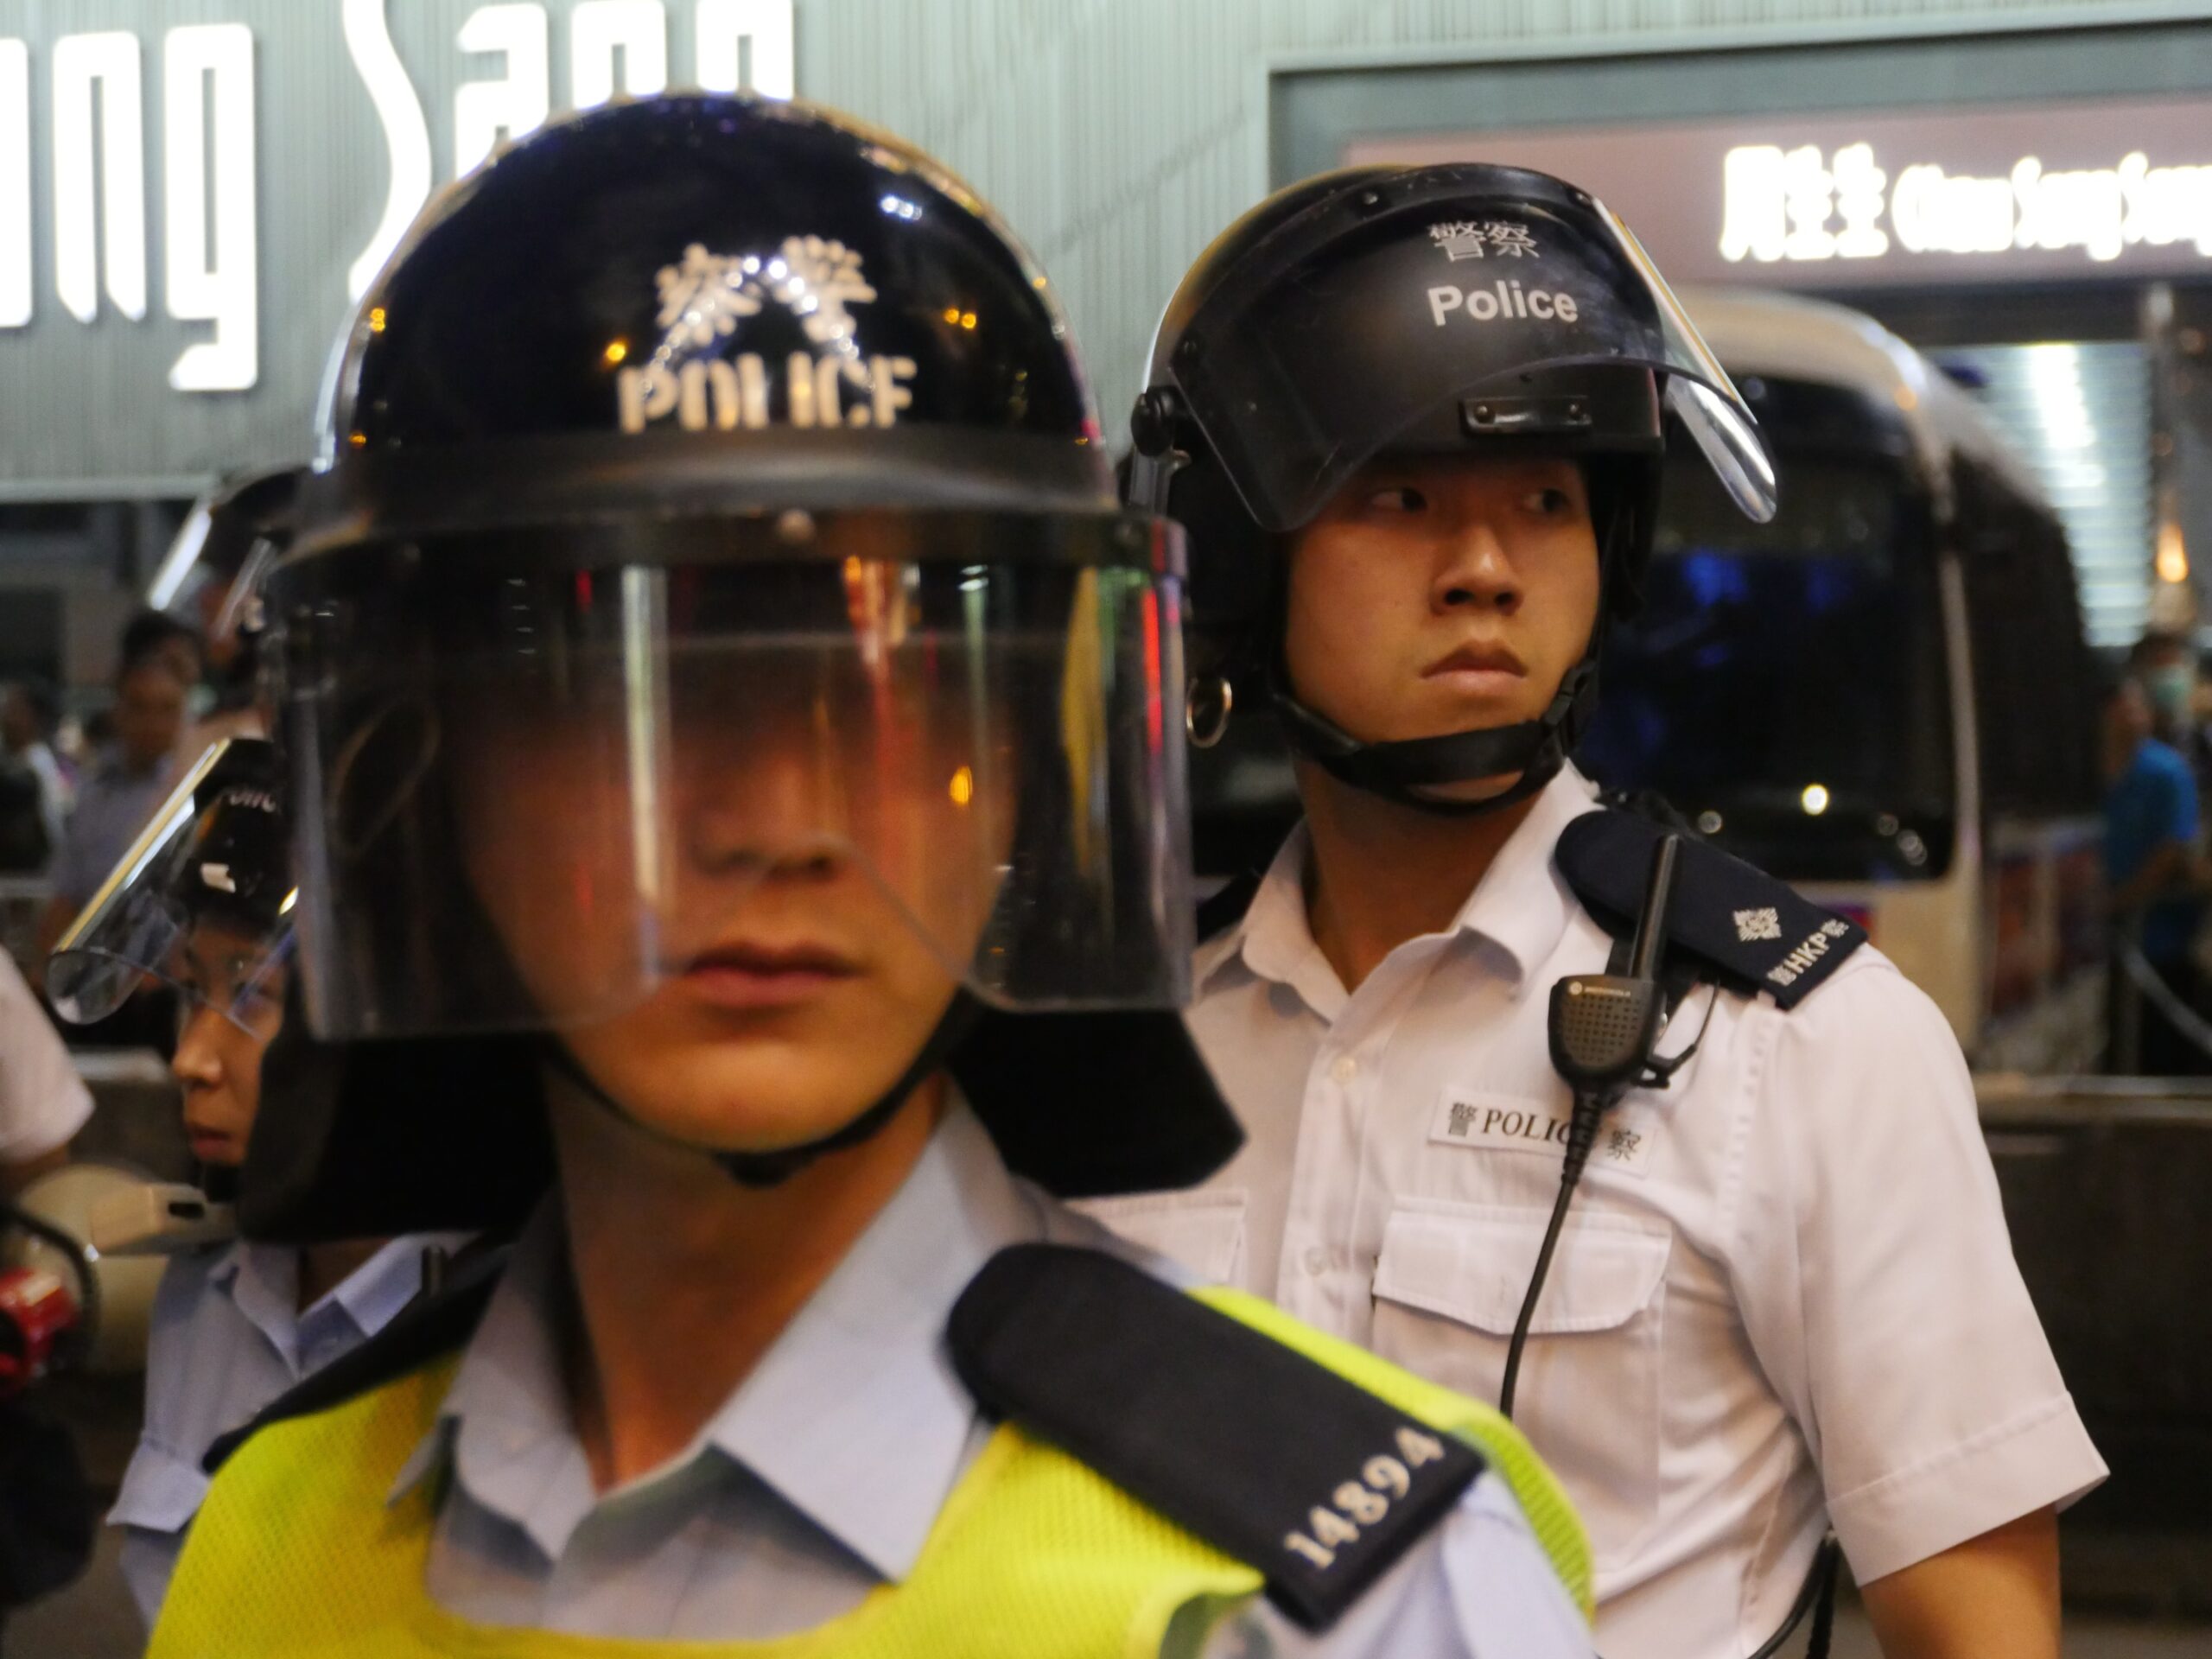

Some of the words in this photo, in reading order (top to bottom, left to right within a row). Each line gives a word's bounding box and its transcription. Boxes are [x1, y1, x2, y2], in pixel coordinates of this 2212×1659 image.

[0, 23, 257, 391] ng
[1428, 220, 1541, 262] 警察
[1427, 279, 1579, 327] Police
[1482, 1105, 1571, 1147] POLIC
[1283, 1427, 1446, 1570] 14894
